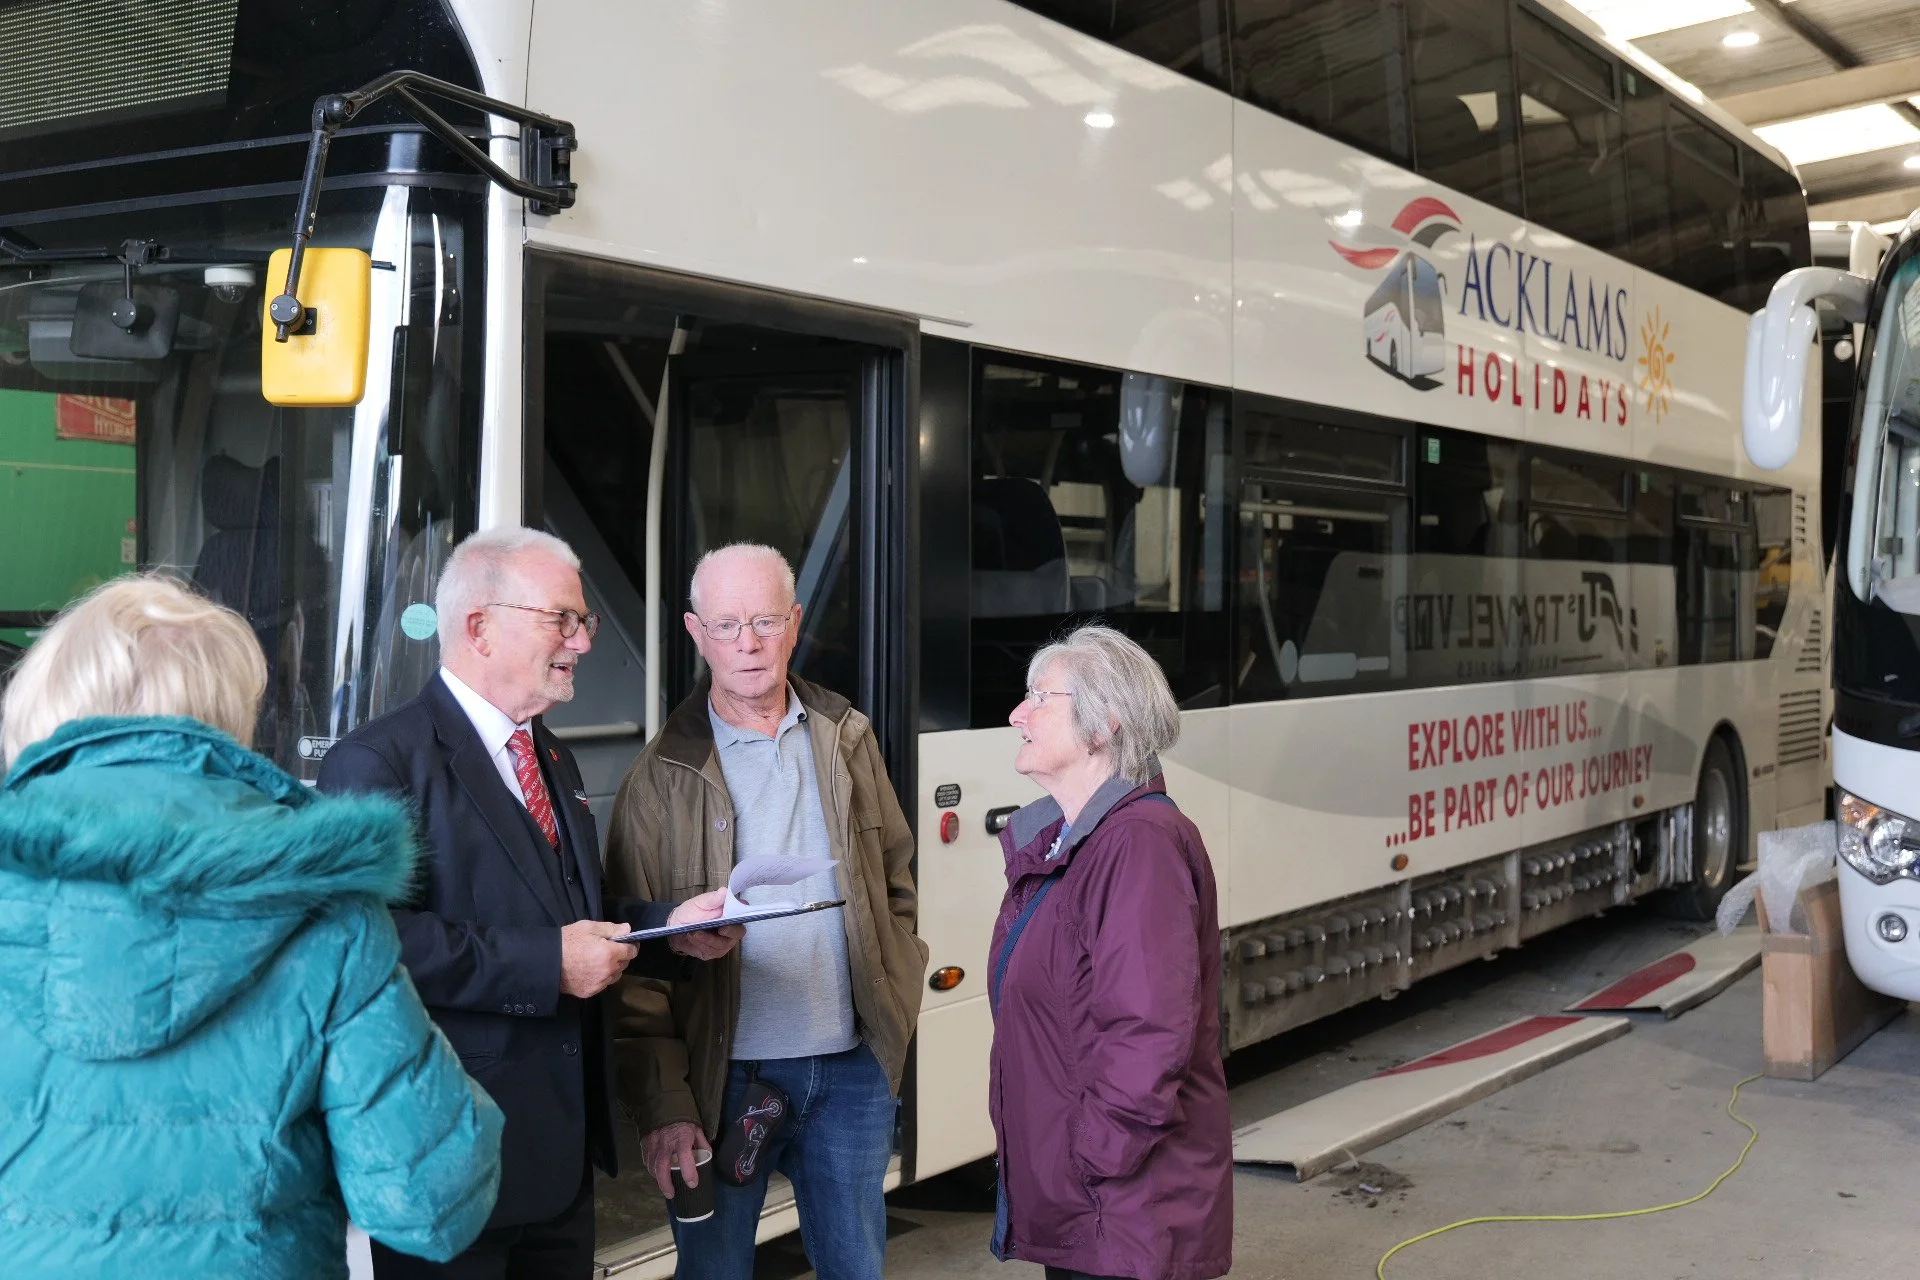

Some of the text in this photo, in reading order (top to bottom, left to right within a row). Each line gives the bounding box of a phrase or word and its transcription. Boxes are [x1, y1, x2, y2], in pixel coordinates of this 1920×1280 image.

[1458, 232, 1628, 361] ACKLAMS
[1457, 344, 1628, 426] HOLIDAYS
[1408, 700, 1602, 771] EXPLORE WITH US...
[1444, 777, 1497, 832] PART
[1503, 771, 1530, 818] OF
[1536, 761, 1574, 810] OUR
[1579, 743, 1653, 798] JOURNEY
